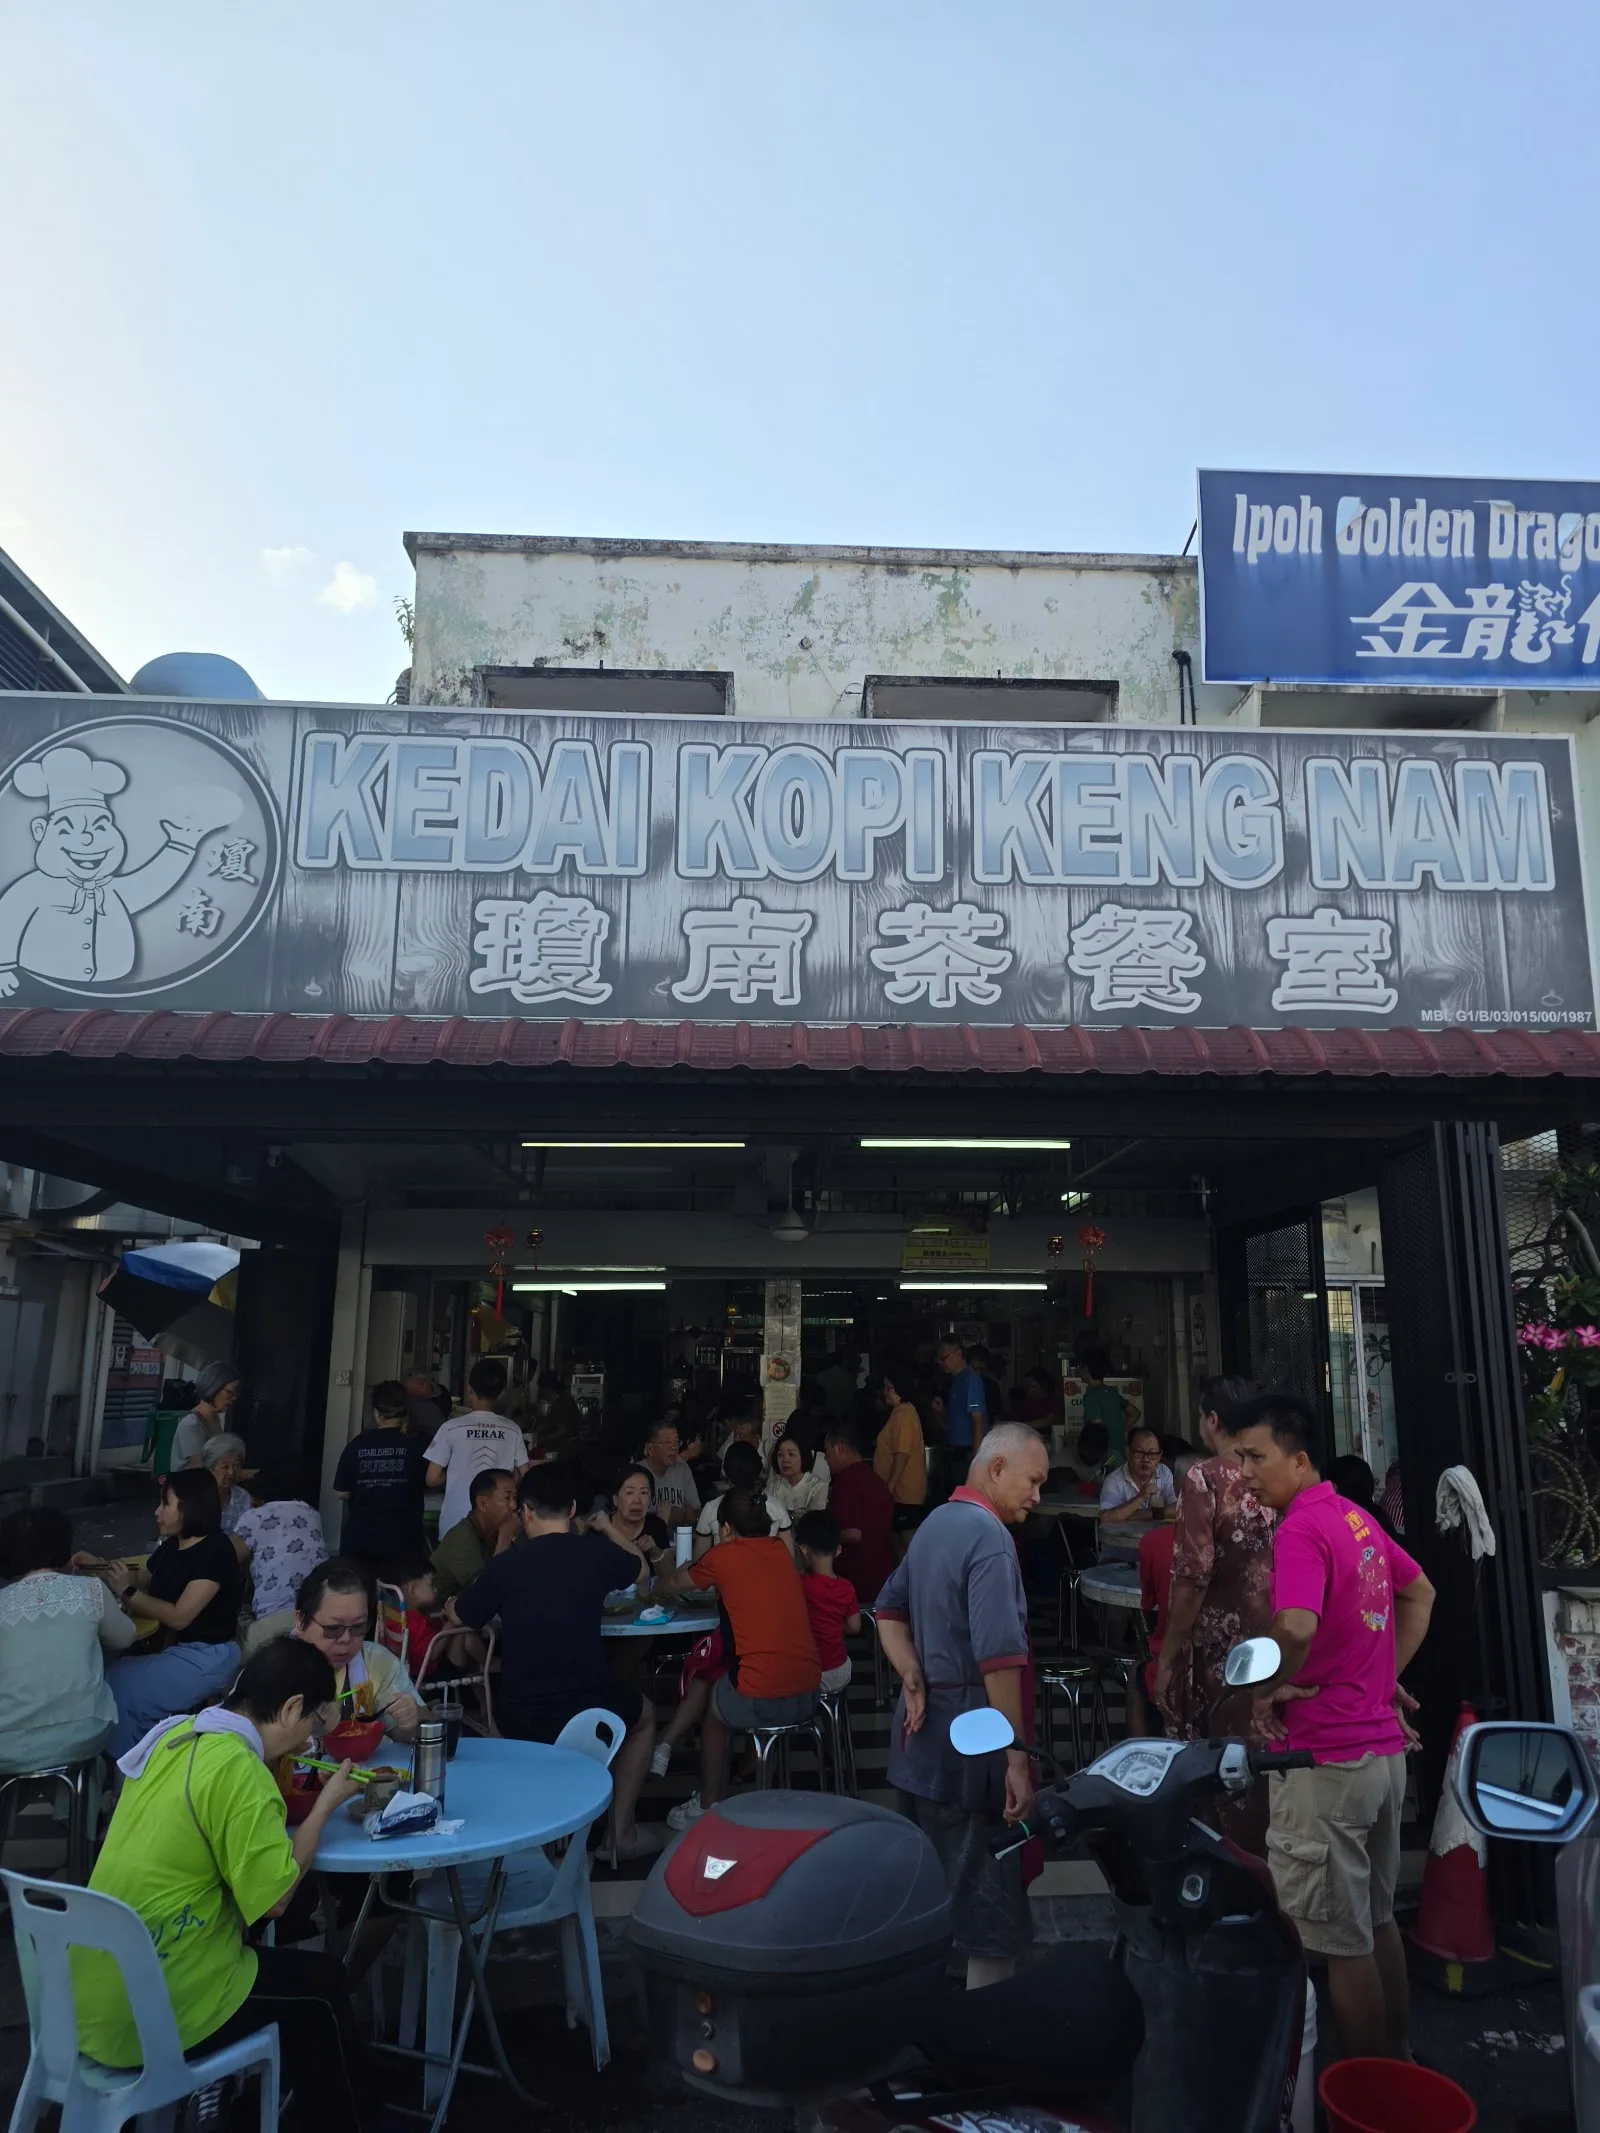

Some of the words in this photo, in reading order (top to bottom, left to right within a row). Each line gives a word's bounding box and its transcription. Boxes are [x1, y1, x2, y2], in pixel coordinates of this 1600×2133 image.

[1233, 494, 1322, 564] Ipoh
[1336, 497, 1475, 557] Golden
[1349, 574, 1600, 663] 金龍
[298, 732, 652, 876] KEDAI
[676, 743, 946, 882] KOPI
[971, 751, 1285, 889] KENG
[1303, 757, 1556, 891] NAM
[1456, 1010, 1592, 1022] G1/B/03/015/00/1987
[466, 1430, 505, 1439] PERAK
[358, 1448, 394, 1458] ESTABLISHED
[359, 1459, 405, 1473] GUESS
[651, 1486, 683, 1506] ONDON
